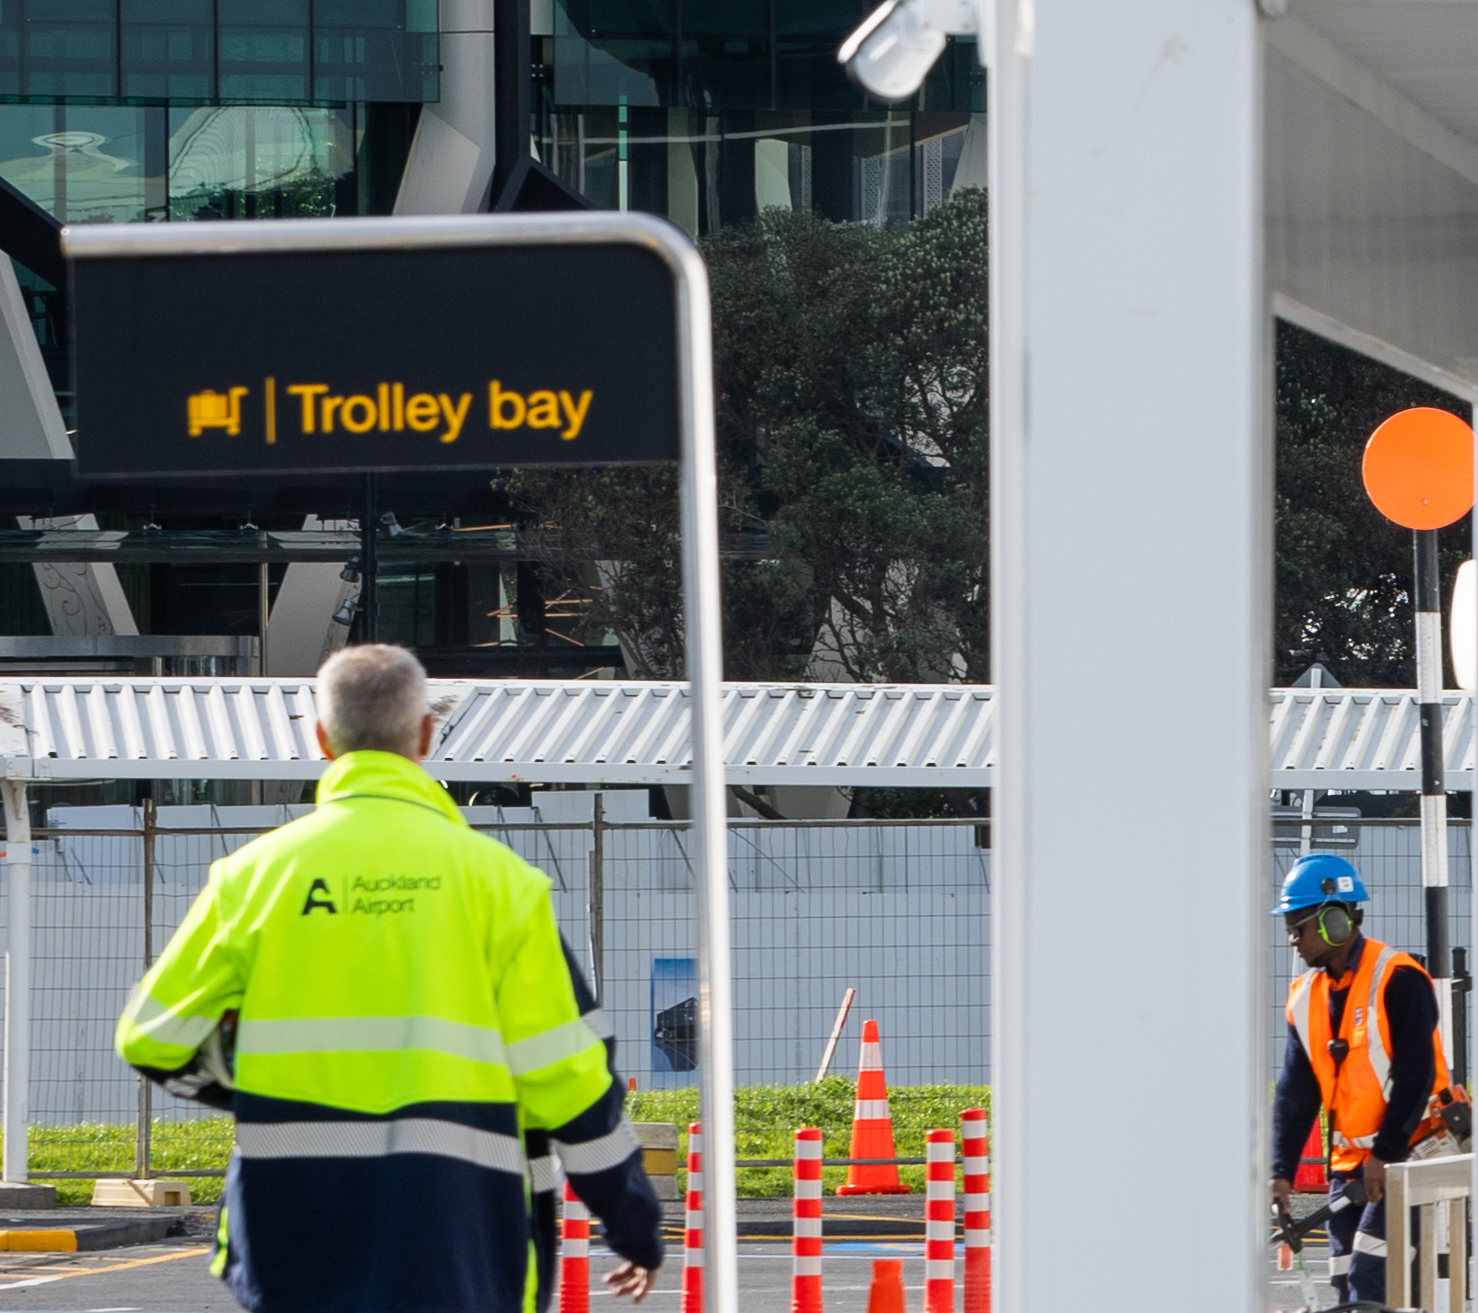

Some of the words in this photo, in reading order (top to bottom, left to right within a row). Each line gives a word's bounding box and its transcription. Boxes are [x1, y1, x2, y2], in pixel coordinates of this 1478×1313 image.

[287, 382, 473, 443] Trolley
[488, 379, 593, 440] bay
[352, 874, 442, 892] Auckland
[352, 898, 415, 915] Airport
